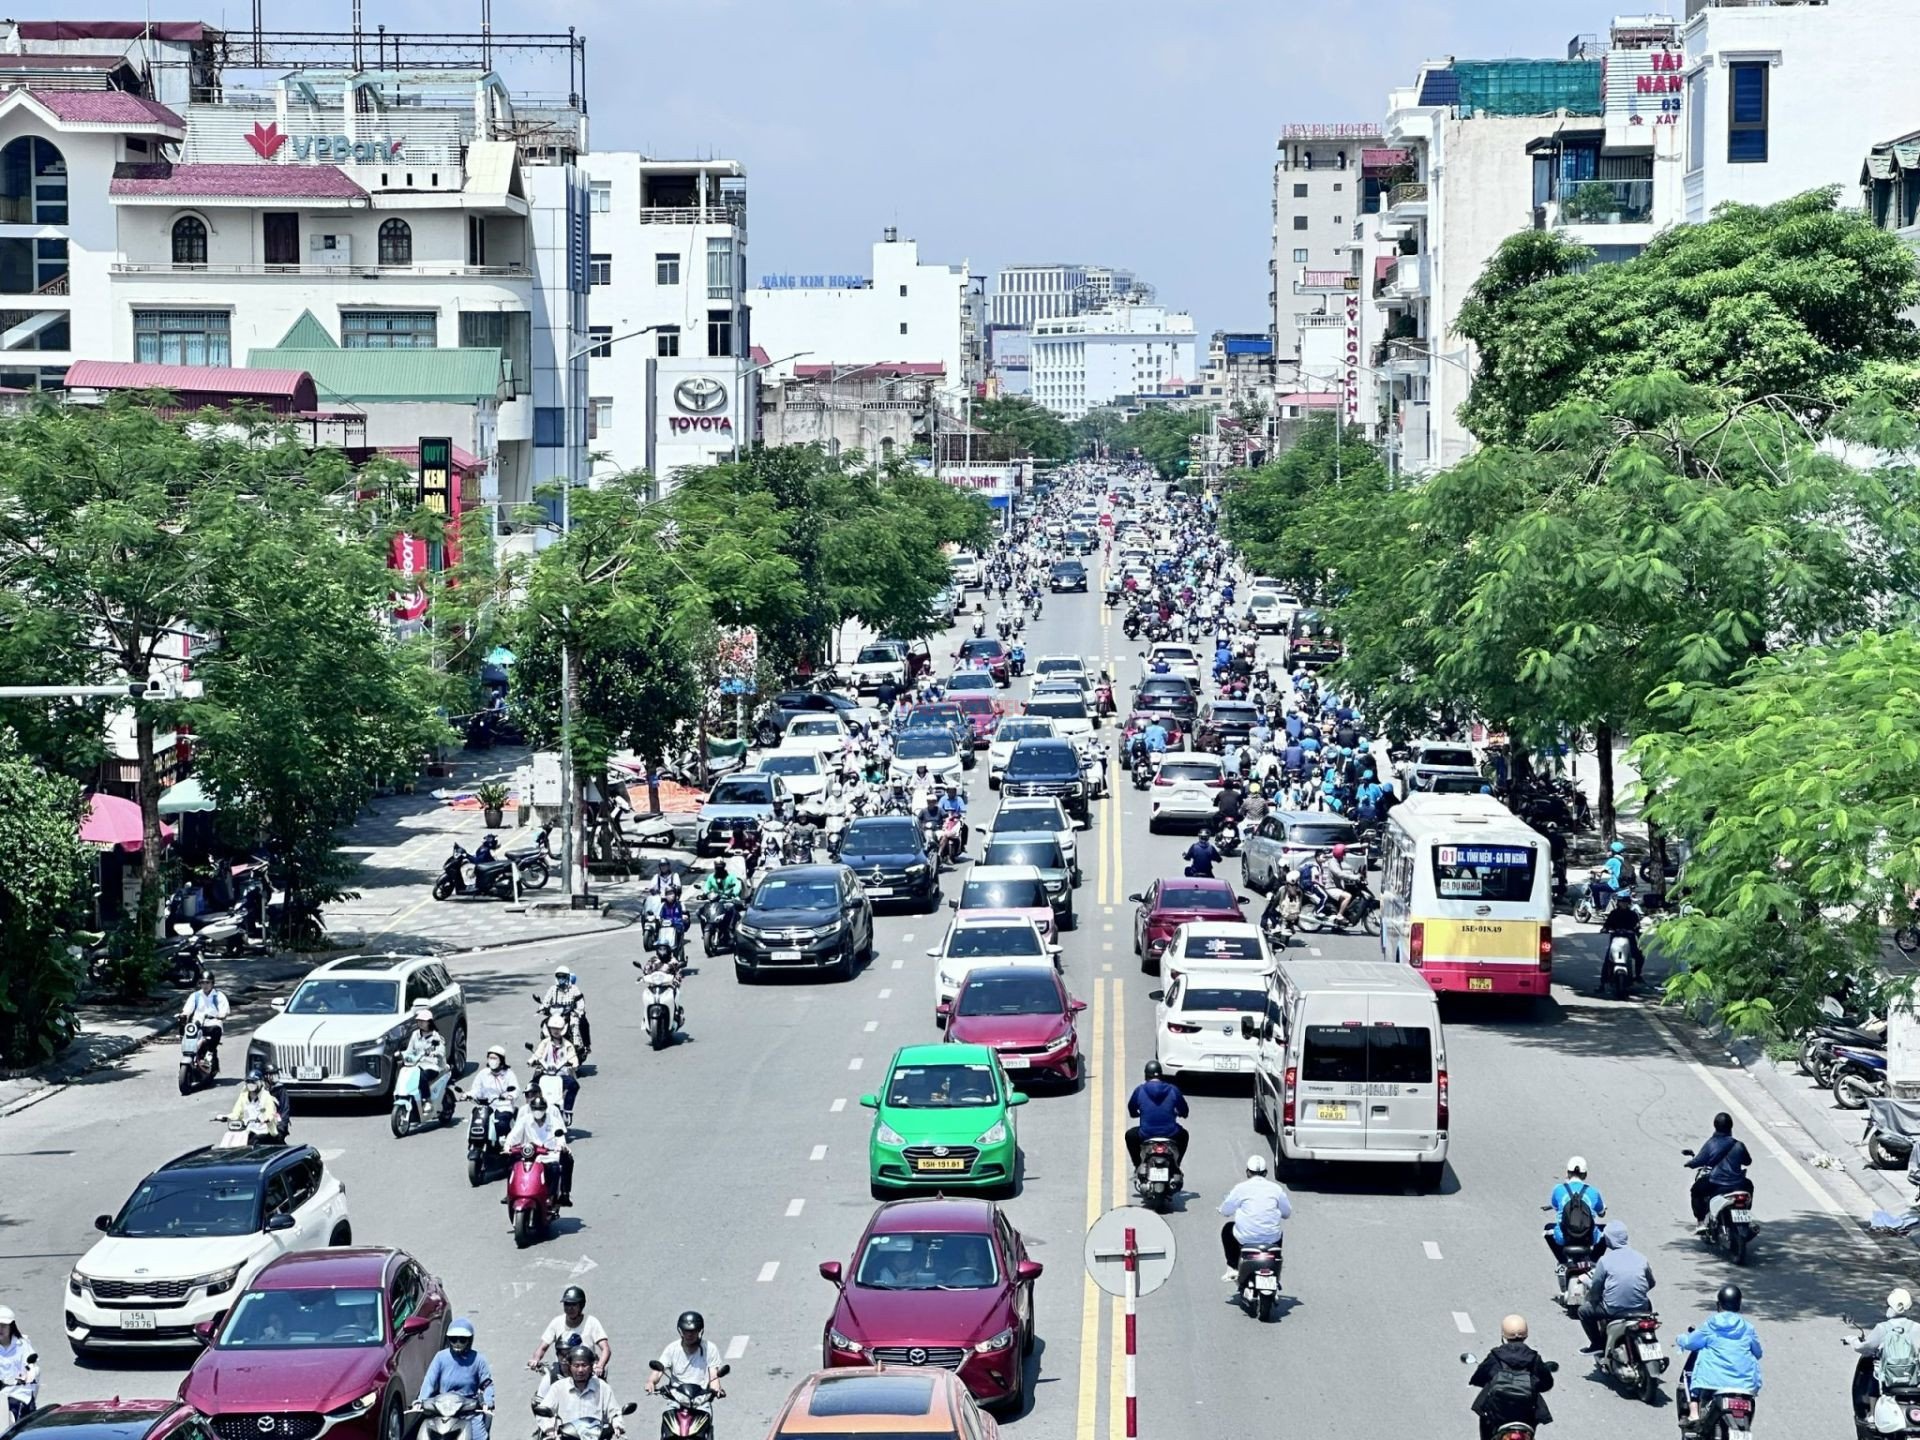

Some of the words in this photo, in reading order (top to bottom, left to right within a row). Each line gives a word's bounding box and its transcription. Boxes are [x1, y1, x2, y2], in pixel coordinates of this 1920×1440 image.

[292, 134, 406, 161] VPBank
[800, 275, 825, 288] KIM
[669, 416, 732, 432] TOYOTA
[424, 469, 446, 489] KEM
[1441, 850, 1455, 863] 01
